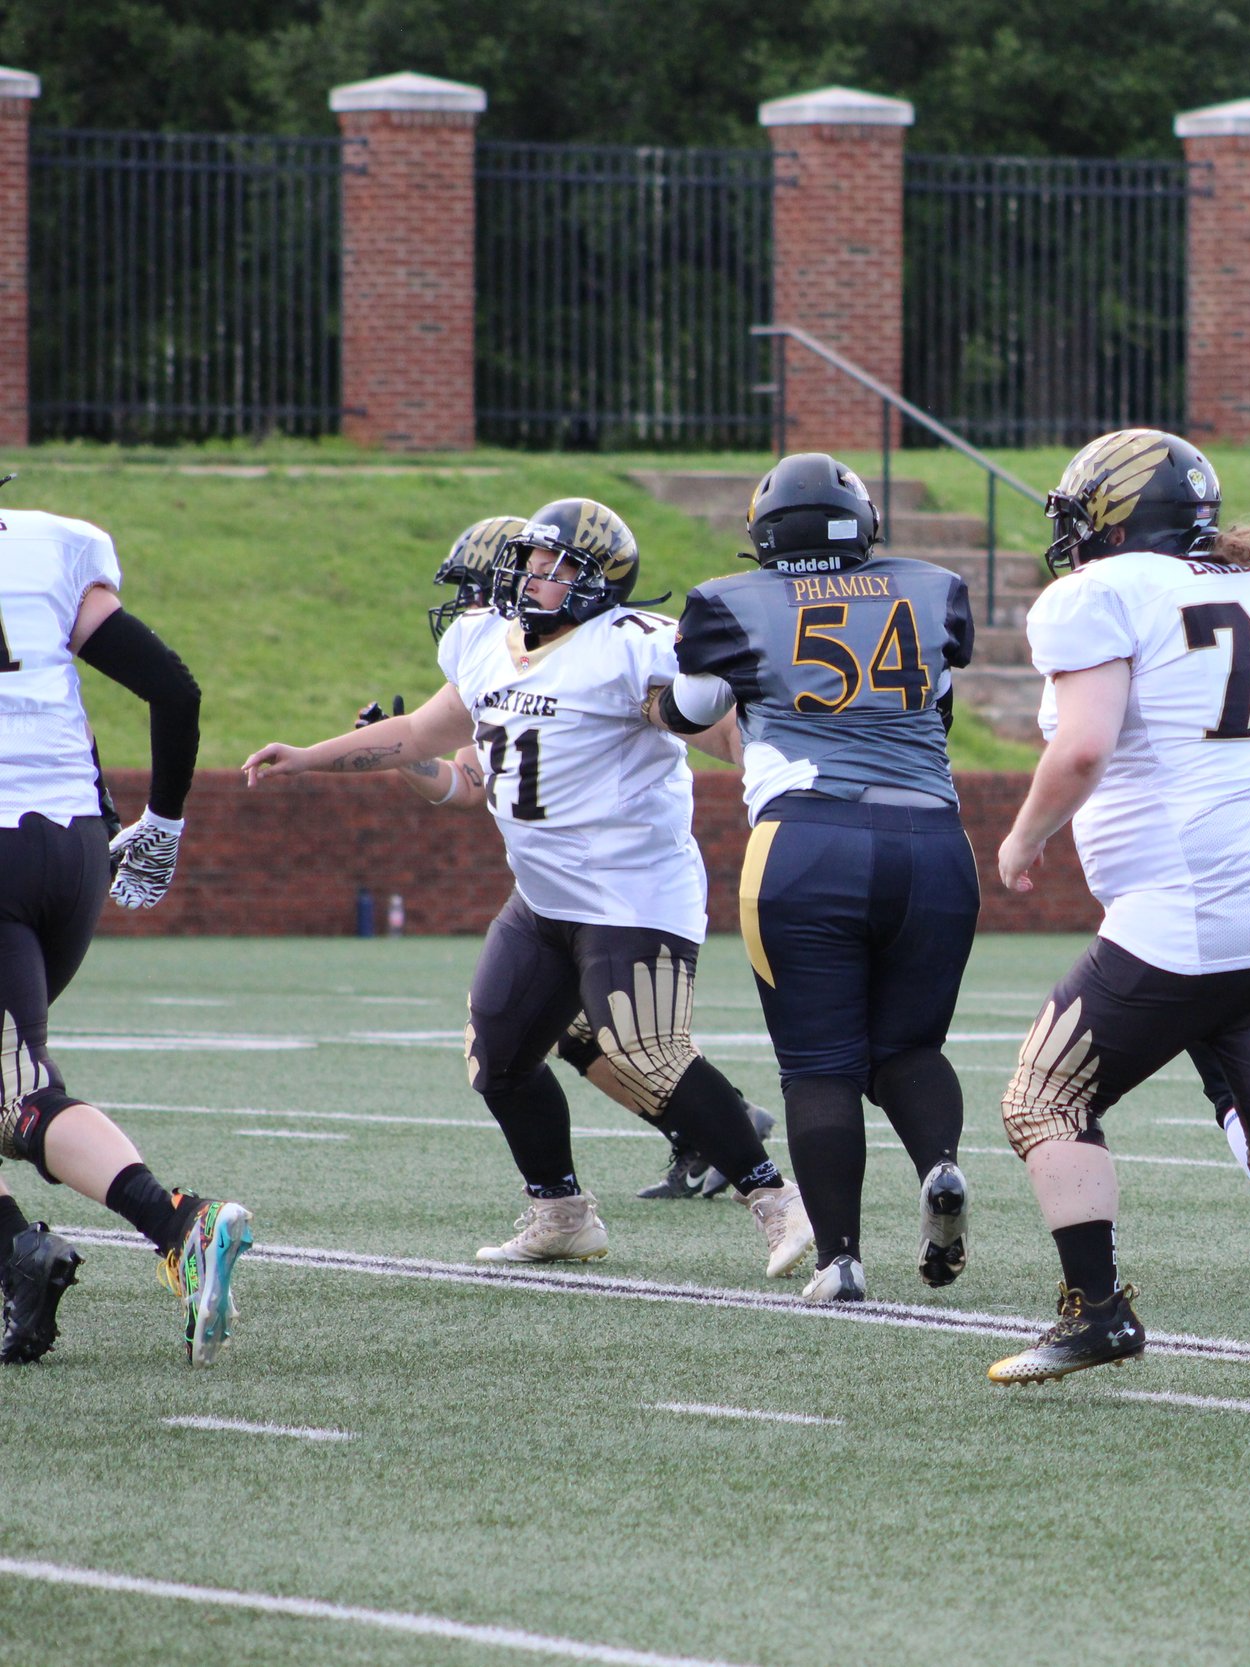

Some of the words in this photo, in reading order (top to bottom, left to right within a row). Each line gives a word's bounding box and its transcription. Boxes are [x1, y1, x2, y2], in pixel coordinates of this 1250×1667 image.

[776, 556, 841, 573] Riddell
[793, 575, 891, 601] PHAMILY
[792, 599, 931, 714] 54
[475, 720, 549, 821] 71
